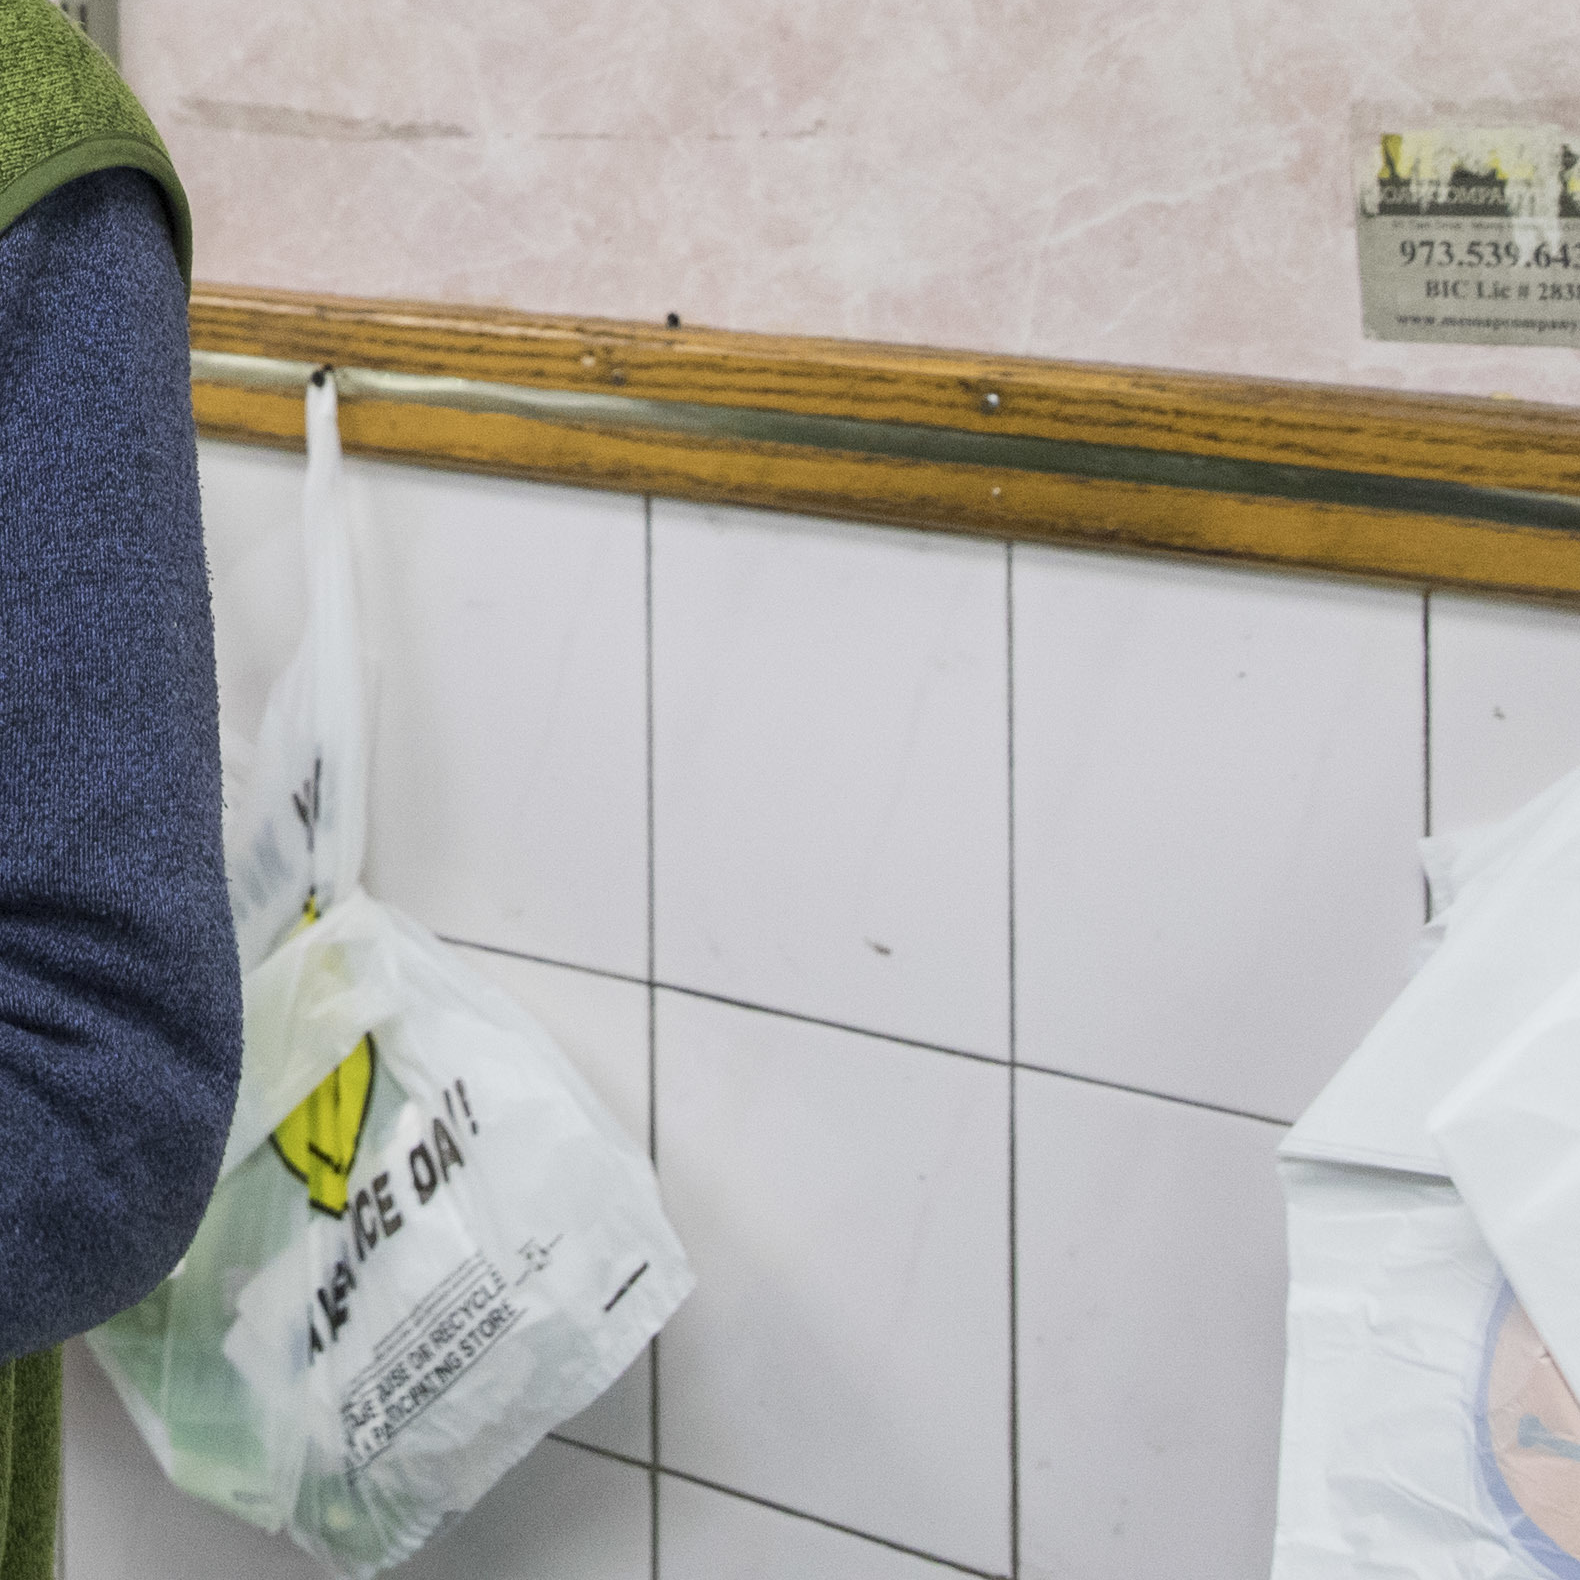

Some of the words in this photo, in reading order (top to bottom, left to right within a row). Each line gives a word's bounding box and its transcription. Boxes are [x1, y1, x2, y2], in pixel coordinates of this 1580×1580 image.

[1425, 278, 1468, 300] BIC
[1475, 279, 1512, 300] Lic
[1517, 283, 1531, 299] #
[428, 1269, 508, 1354] RECYCLE
[459, 1300, 519, 1362] STORE
